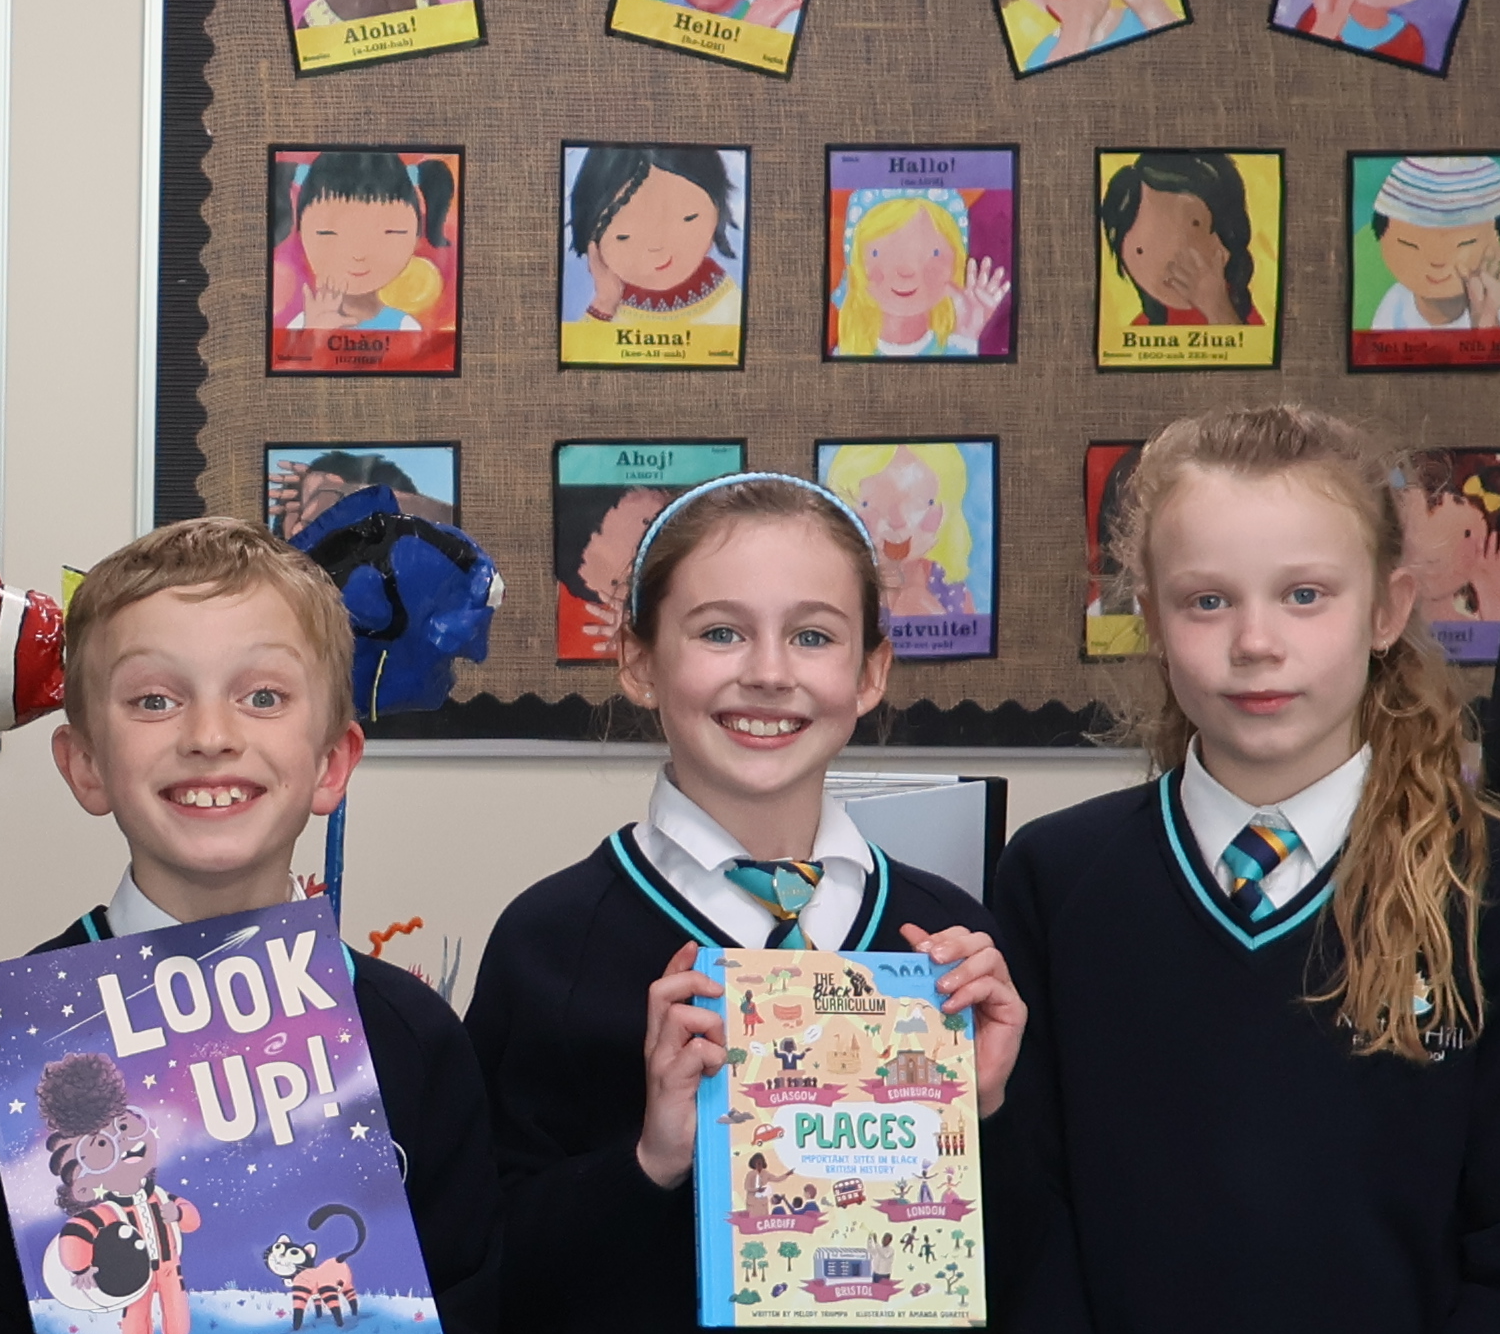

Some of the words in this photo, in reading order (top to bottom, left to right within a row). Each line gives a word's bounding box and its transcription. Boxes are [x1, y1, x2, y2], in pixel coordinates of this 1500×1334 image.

[343, 15, 416, 44] Aloha!
[673, 13, 741, 43] Hello!
[888, 157, 955, 173] Hallo!
[327, 334, 390, 352] Chào!
[616, 329, 691, 346] Kiana!
[1122, 332, 1180, 348] Buna
[1187, 332, 1243, 348] Ziua!
[616, 451, 673, 470] Ahoj!
[813, 972, 835, 986] THE
[97, 930, 337, 1058] LOOK
[813, 982, 852, 1001] BLACK
[815, 998, 886, 1012] CURRICULUM
[190, 1035, 340, 1146] UP!
[769, 1091, 817, 1104] GLASGOW
[888, 1088, 942, 1100] EDINBURGH
[795, 1112, 916, 1149] PLACES
[801, 1155, 849, 1164] IMPORTANT
[854, 1155, 875, 1164] SITES
[878, 1155, 888, 1164] IN
[891, 1155, 918, 1165] BLACK
[825, 1165, 856, 1174] BRITISH
[860, 1166, 895, 1174] HISTORY
[907, 1206, 946, 1218] LONDON
[756, 1218, 796, 1230] CARDIFF
[835, 1285, 873, 1297] BRISTOL
